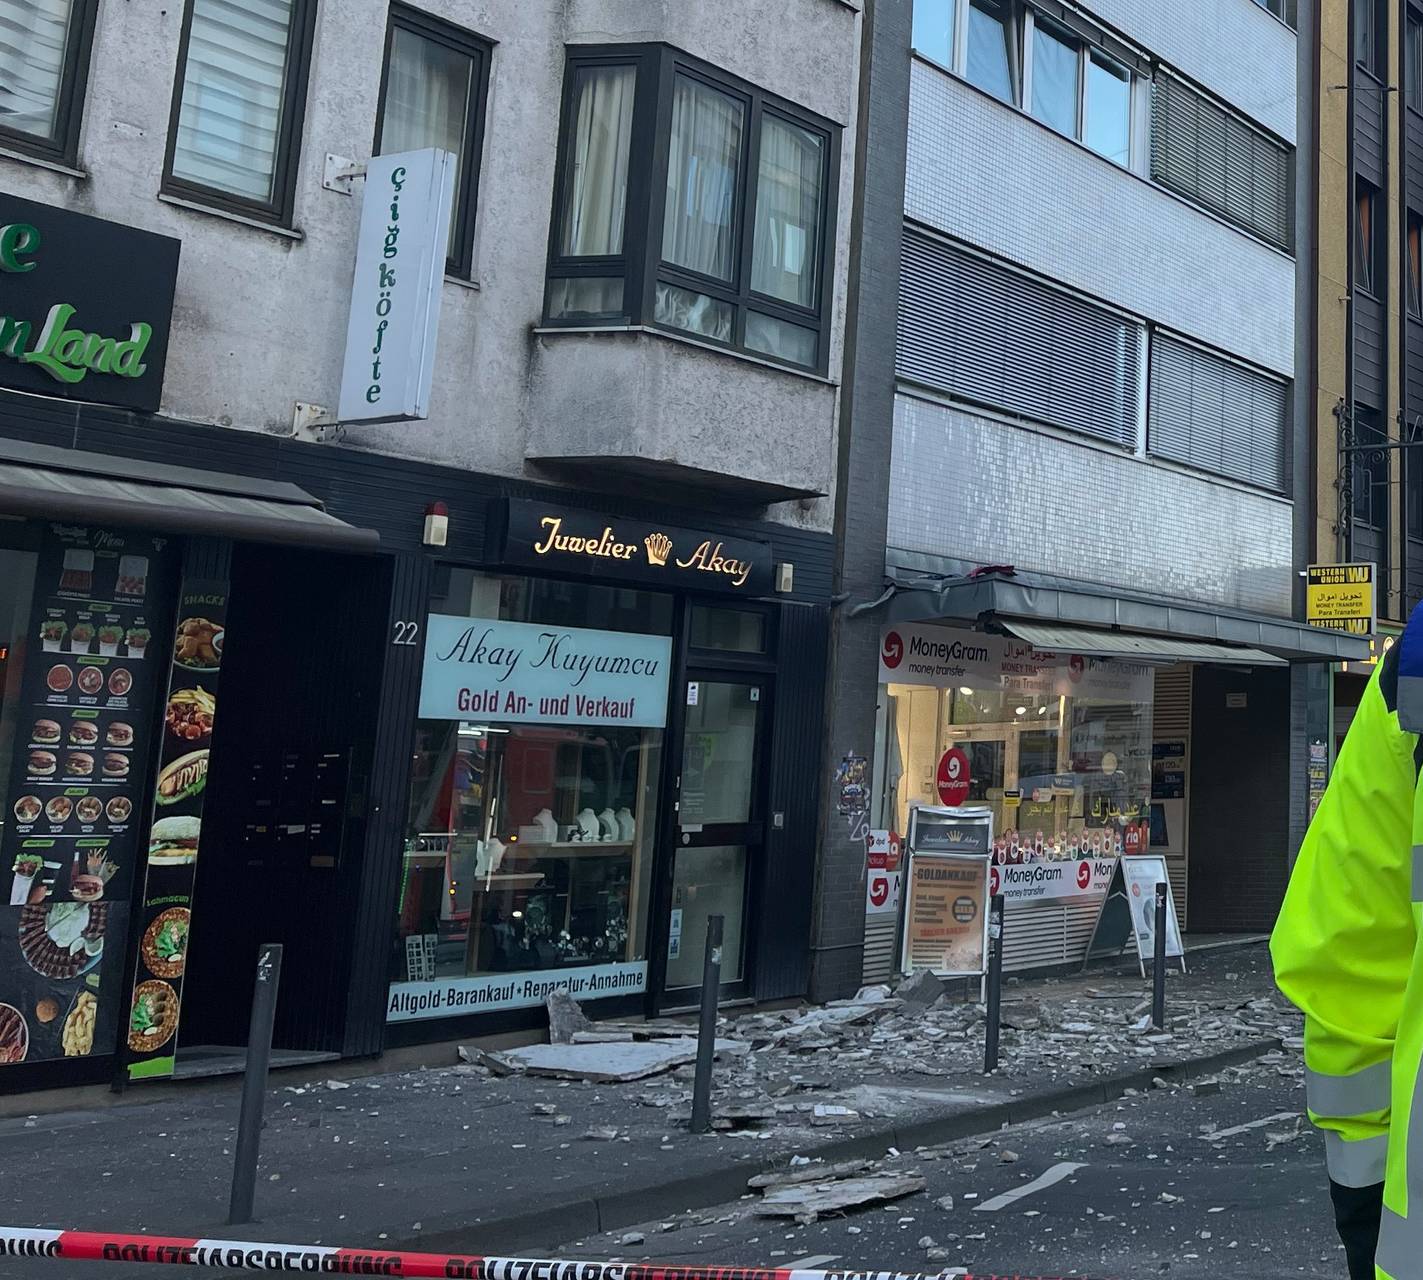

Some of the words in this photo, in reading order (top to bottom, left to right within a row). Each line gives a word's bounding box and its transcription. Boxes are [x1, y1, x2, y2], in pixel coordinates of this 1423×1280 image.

[24, 303, 153, 384] Land
[534, 517, 637, 560] Juwelier
[675, 540, 753, 586] Akay
[1310, 568, 1345, 576] WESTERN
[1320, 575, 1345, 584] UNION
[183, 594, 226, 606] SNACKS
[1334, 608, 1361, 616] Transferi
[393, 621, 418, 646] 22
[435, 626, 524, 683] Akay
[909, 635, 989, 662] MoneyGram
[909, 665, 936, 679] money
[936, 666, 966, 678] transfer
[457, 687, 499, 713] Gold
[504, 691, 534, 714] An-
[539, 693, 569, 716] und
[575, 695, 635, 720] Verkauf
[938, 778, 969, 789] MoneyGram
[875, 838, 886, 847] dpd
[1125, 827, 1139, 844] ria
[1003, 865, 1064, 887] MoneyGram
[1003, 888, 1021, 899] money
[1022, 886, 1046, 897] transfer
[389, 983, 516, 1014] Altgold-Barankauf
